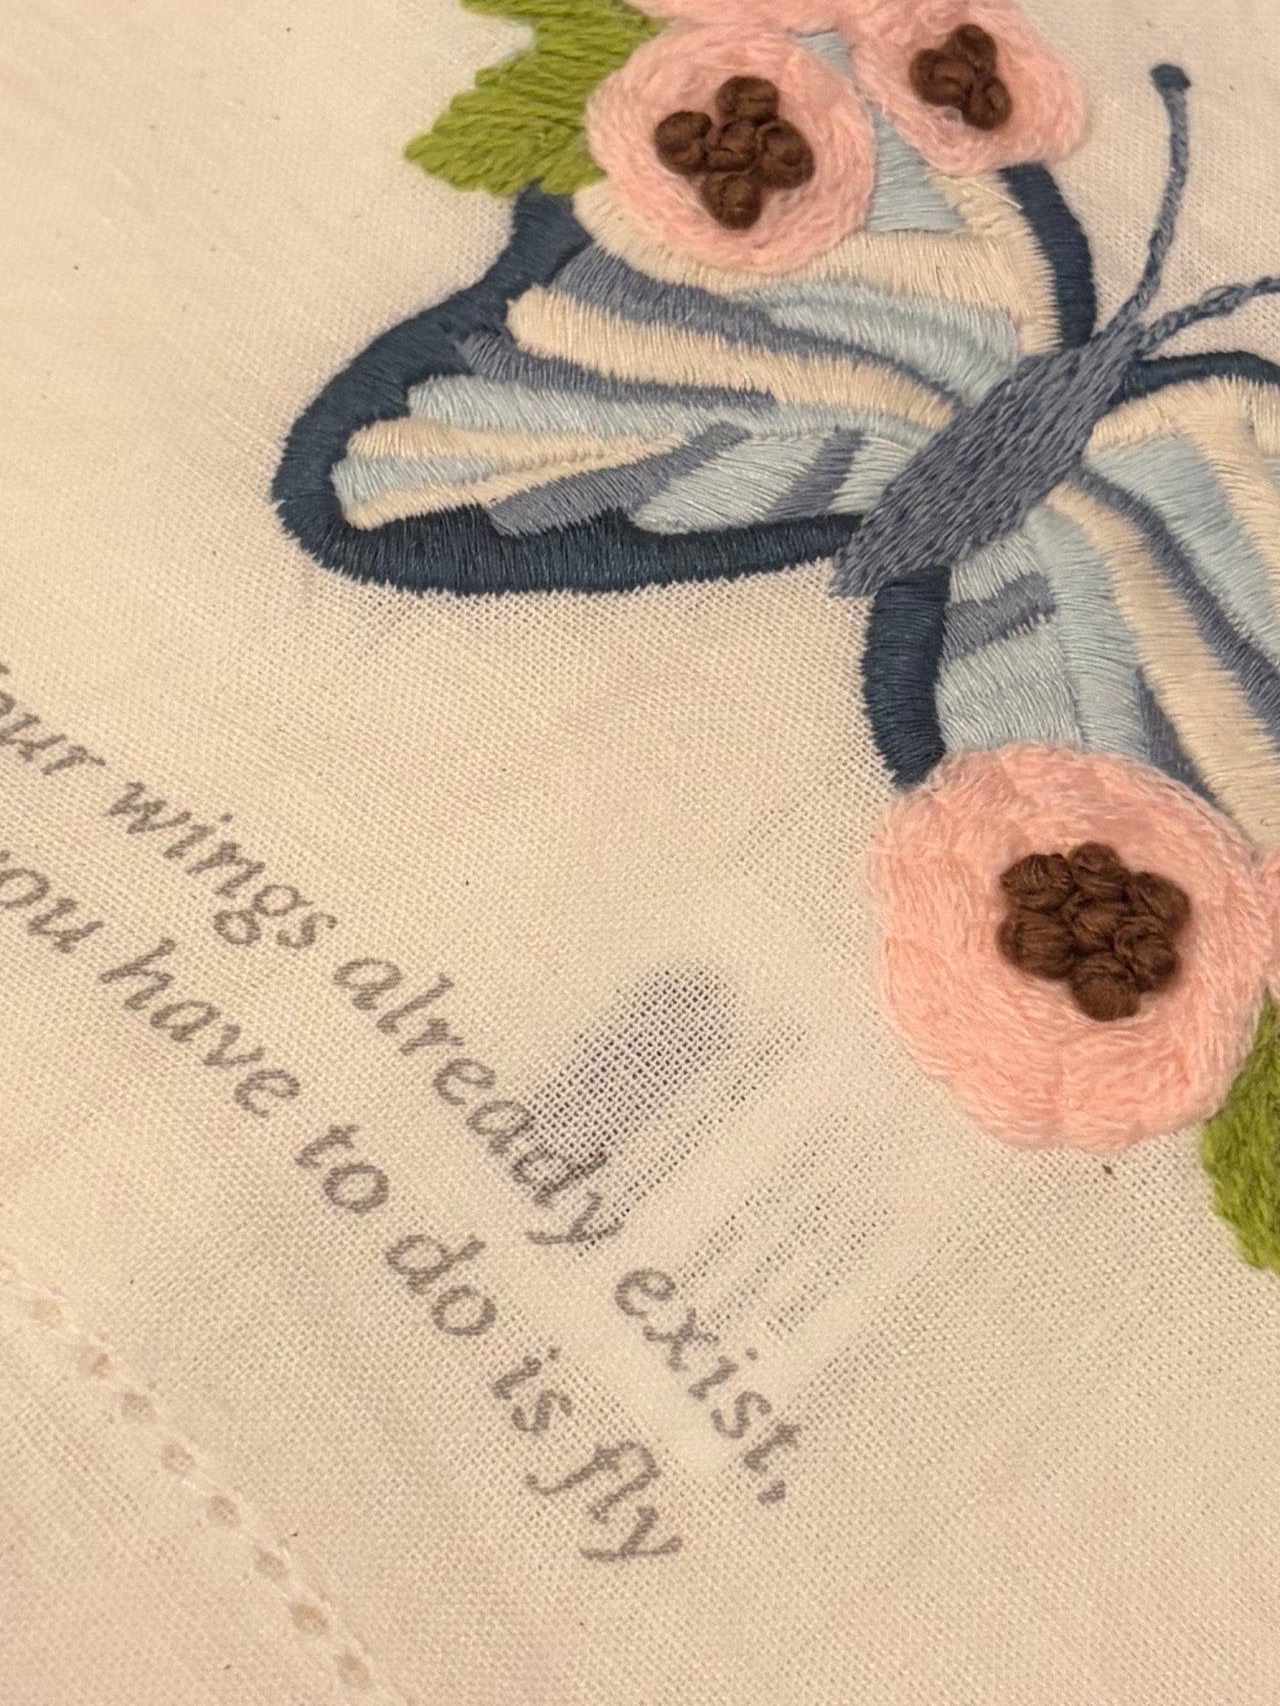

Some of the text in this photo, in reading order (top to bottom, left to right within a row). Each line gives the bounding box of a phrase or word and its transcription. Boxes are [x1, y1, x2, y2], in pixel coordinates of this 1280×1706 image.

[101, 937, 301, 1120] have
[108, 778, 339, 952] wings
[332, 955, 626, 1246] already
[615, 1268, 803, 1506] exist,
[292, 1120, 391, 1216] to
[385, 1229, 497, 1339] do
[491, 1347, 573, 1436] is
[526, 1439, 683, 1566] fly
